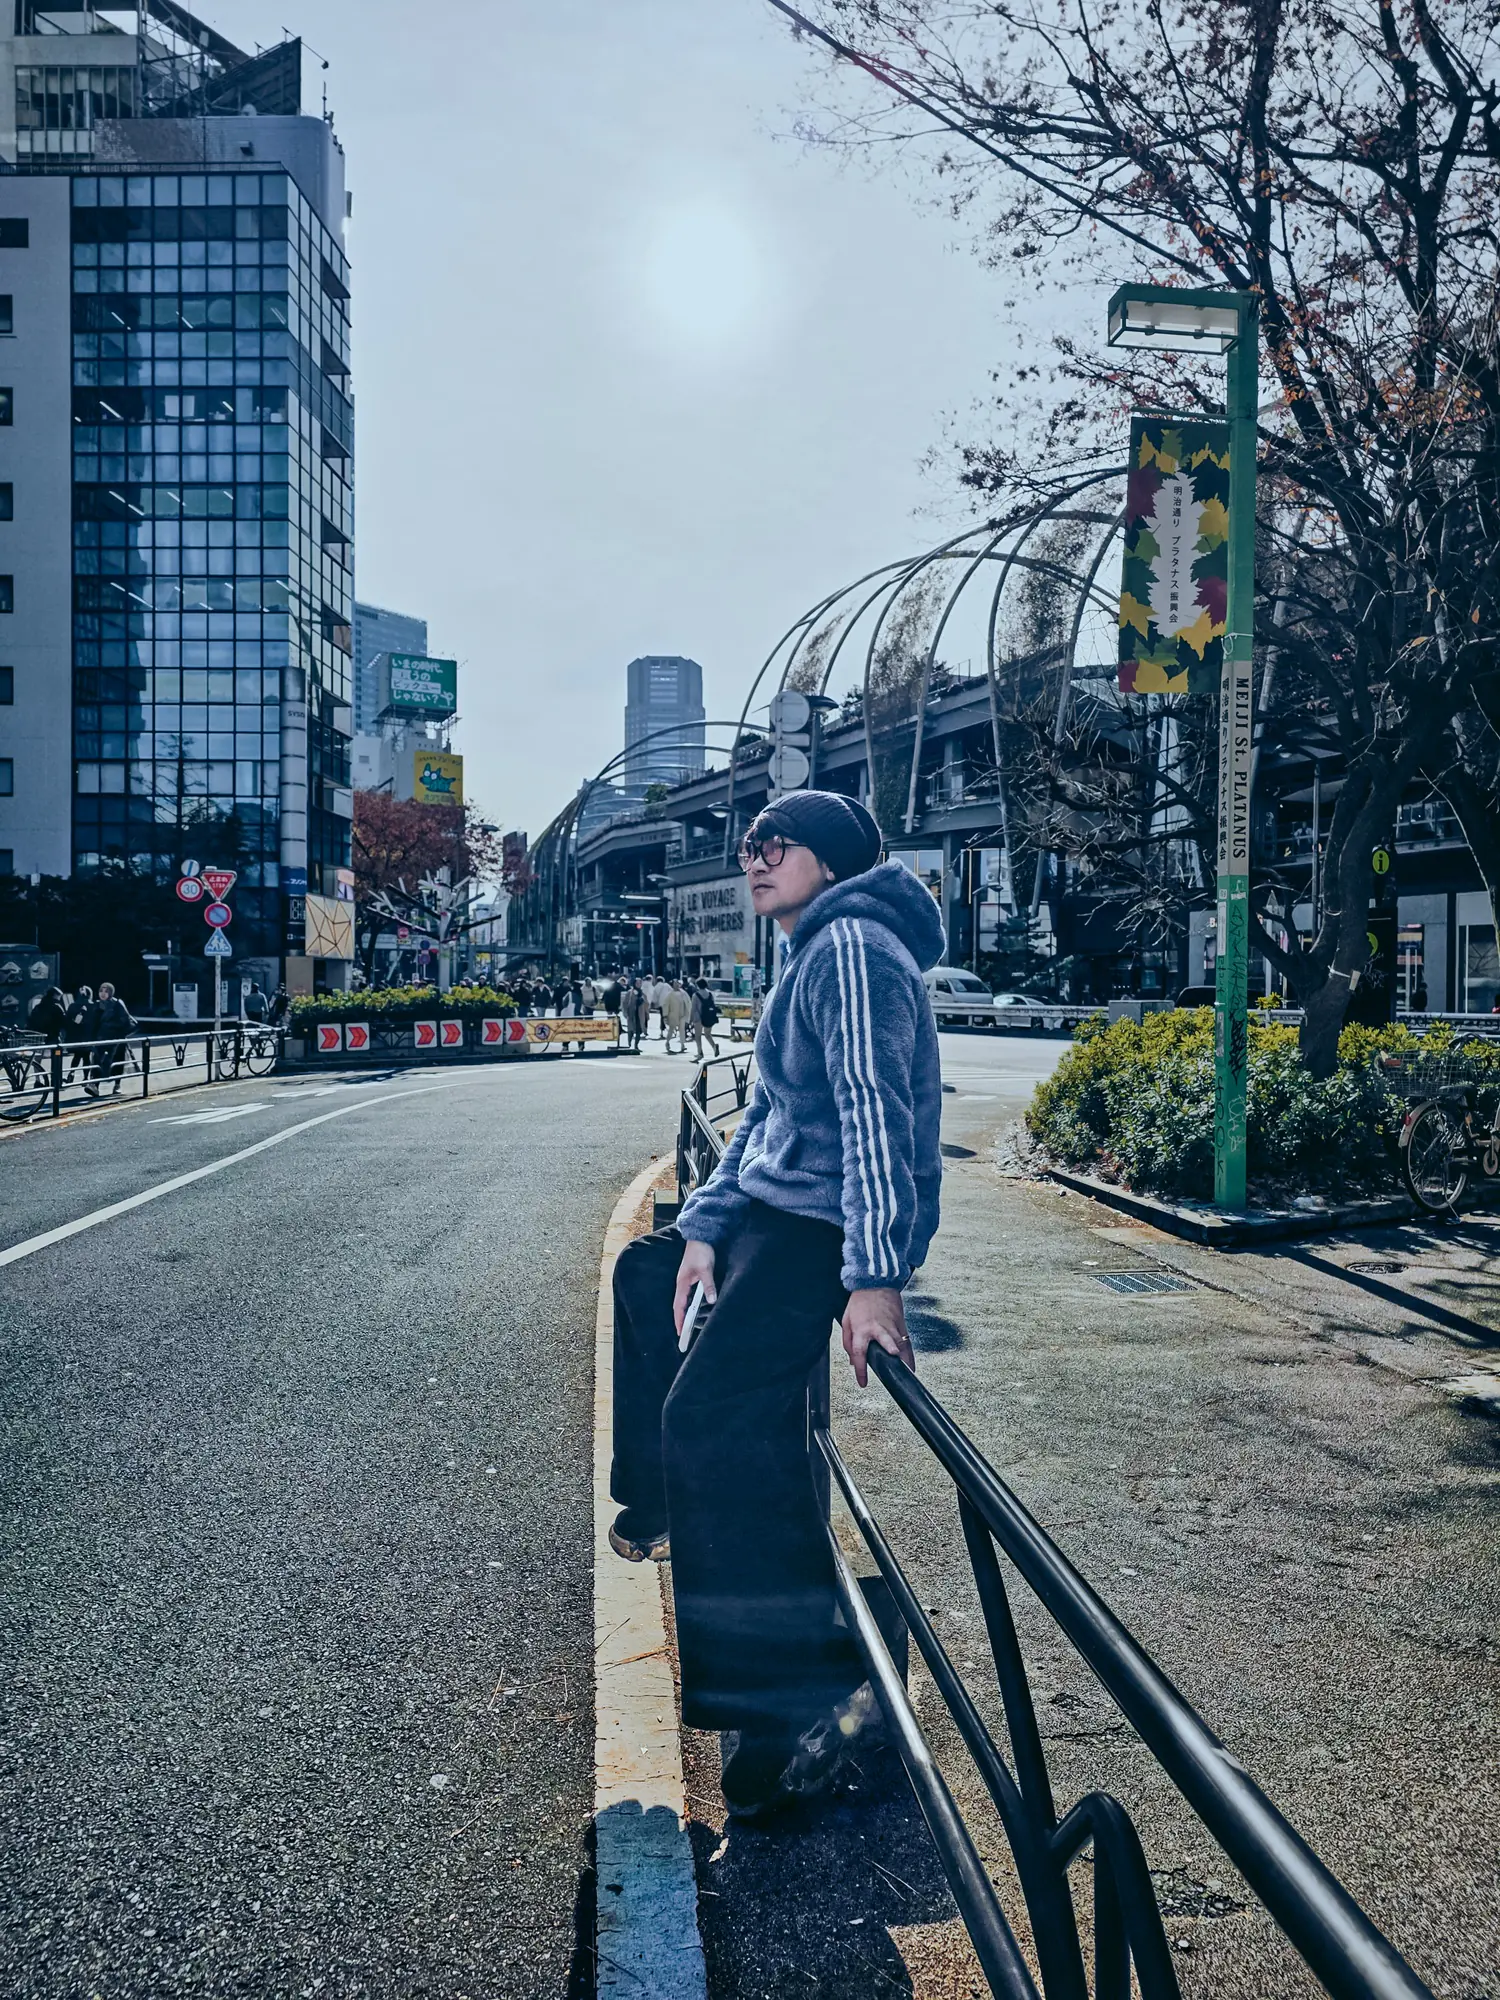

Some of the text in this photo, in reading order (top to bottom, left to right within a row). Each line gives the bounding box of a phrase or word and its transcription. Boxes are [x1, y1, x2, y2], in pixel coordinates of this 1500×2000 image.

[1172, 486, 1183, 528] 明治通り
[1233, 677, 1249, 858] MEIJI St. PLATANUS
[183, 884, 198, 895] 30
[687, 887, 736, 911] LE VOYAGE
